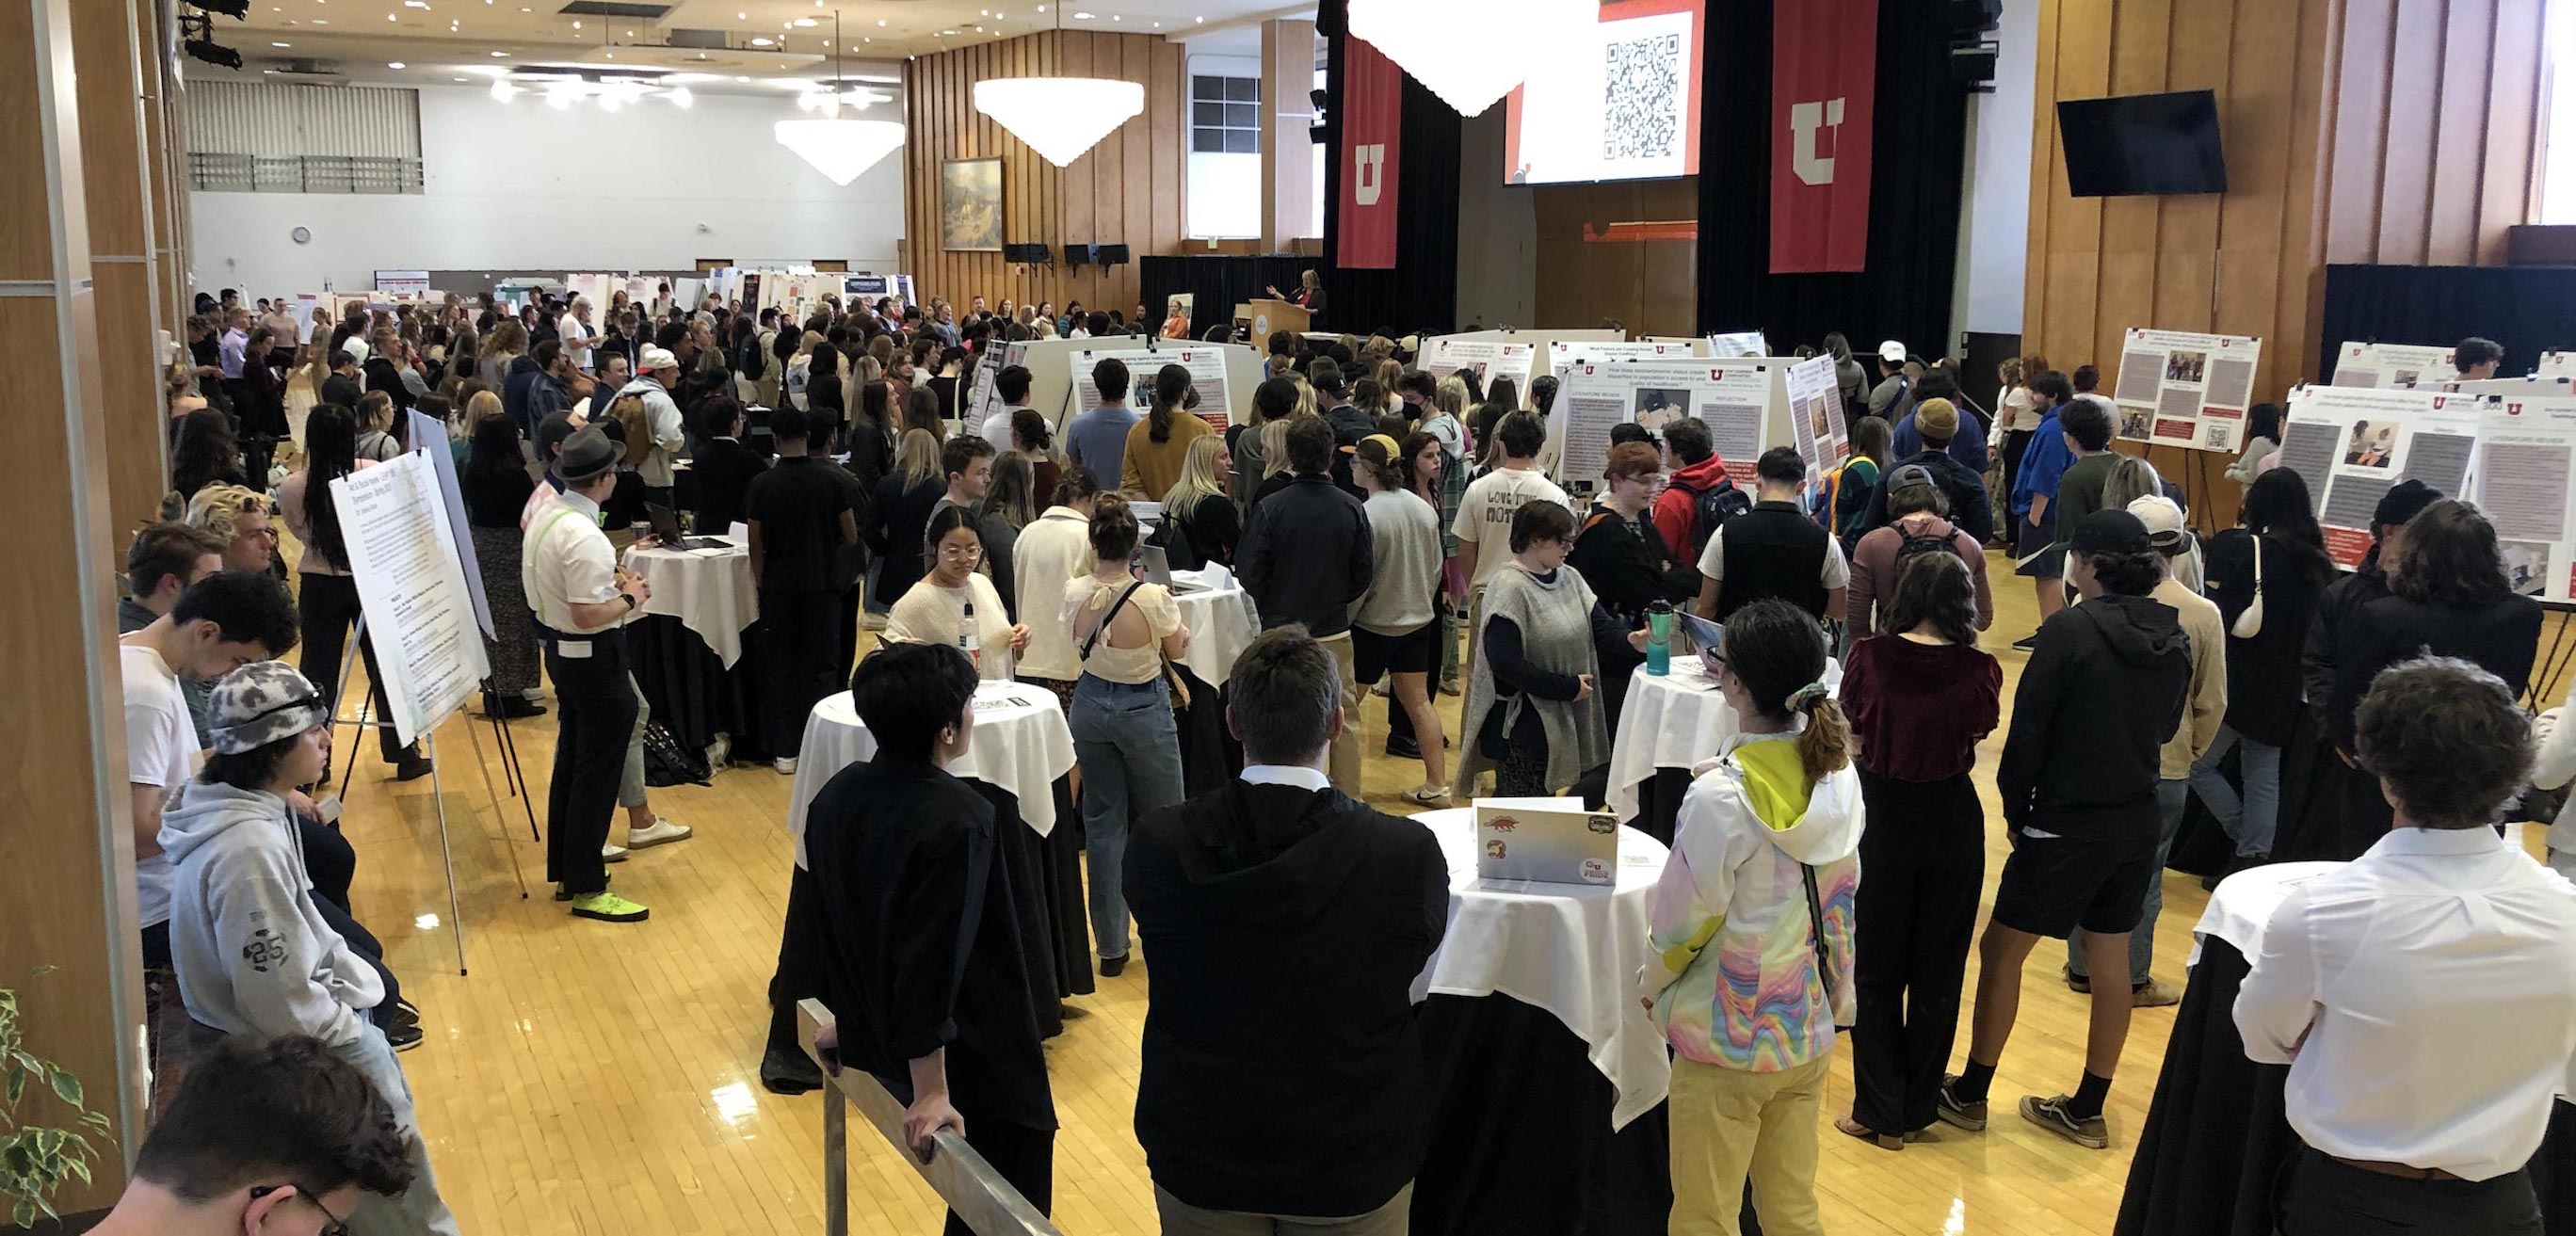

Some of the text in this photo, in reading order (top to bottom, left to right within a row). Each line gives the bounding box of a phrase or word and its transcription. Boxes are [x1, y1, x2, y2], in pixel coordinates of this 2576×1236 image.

[1791, 97, 1844, 185] U
[1356, 143, 1385, 205] U
[1710, 369, 1725, 381] U
[2507, 403, 2522, 415] U
[1488, 491, 1512, 504] LOVE
[250, 936, 285, 963] 25
